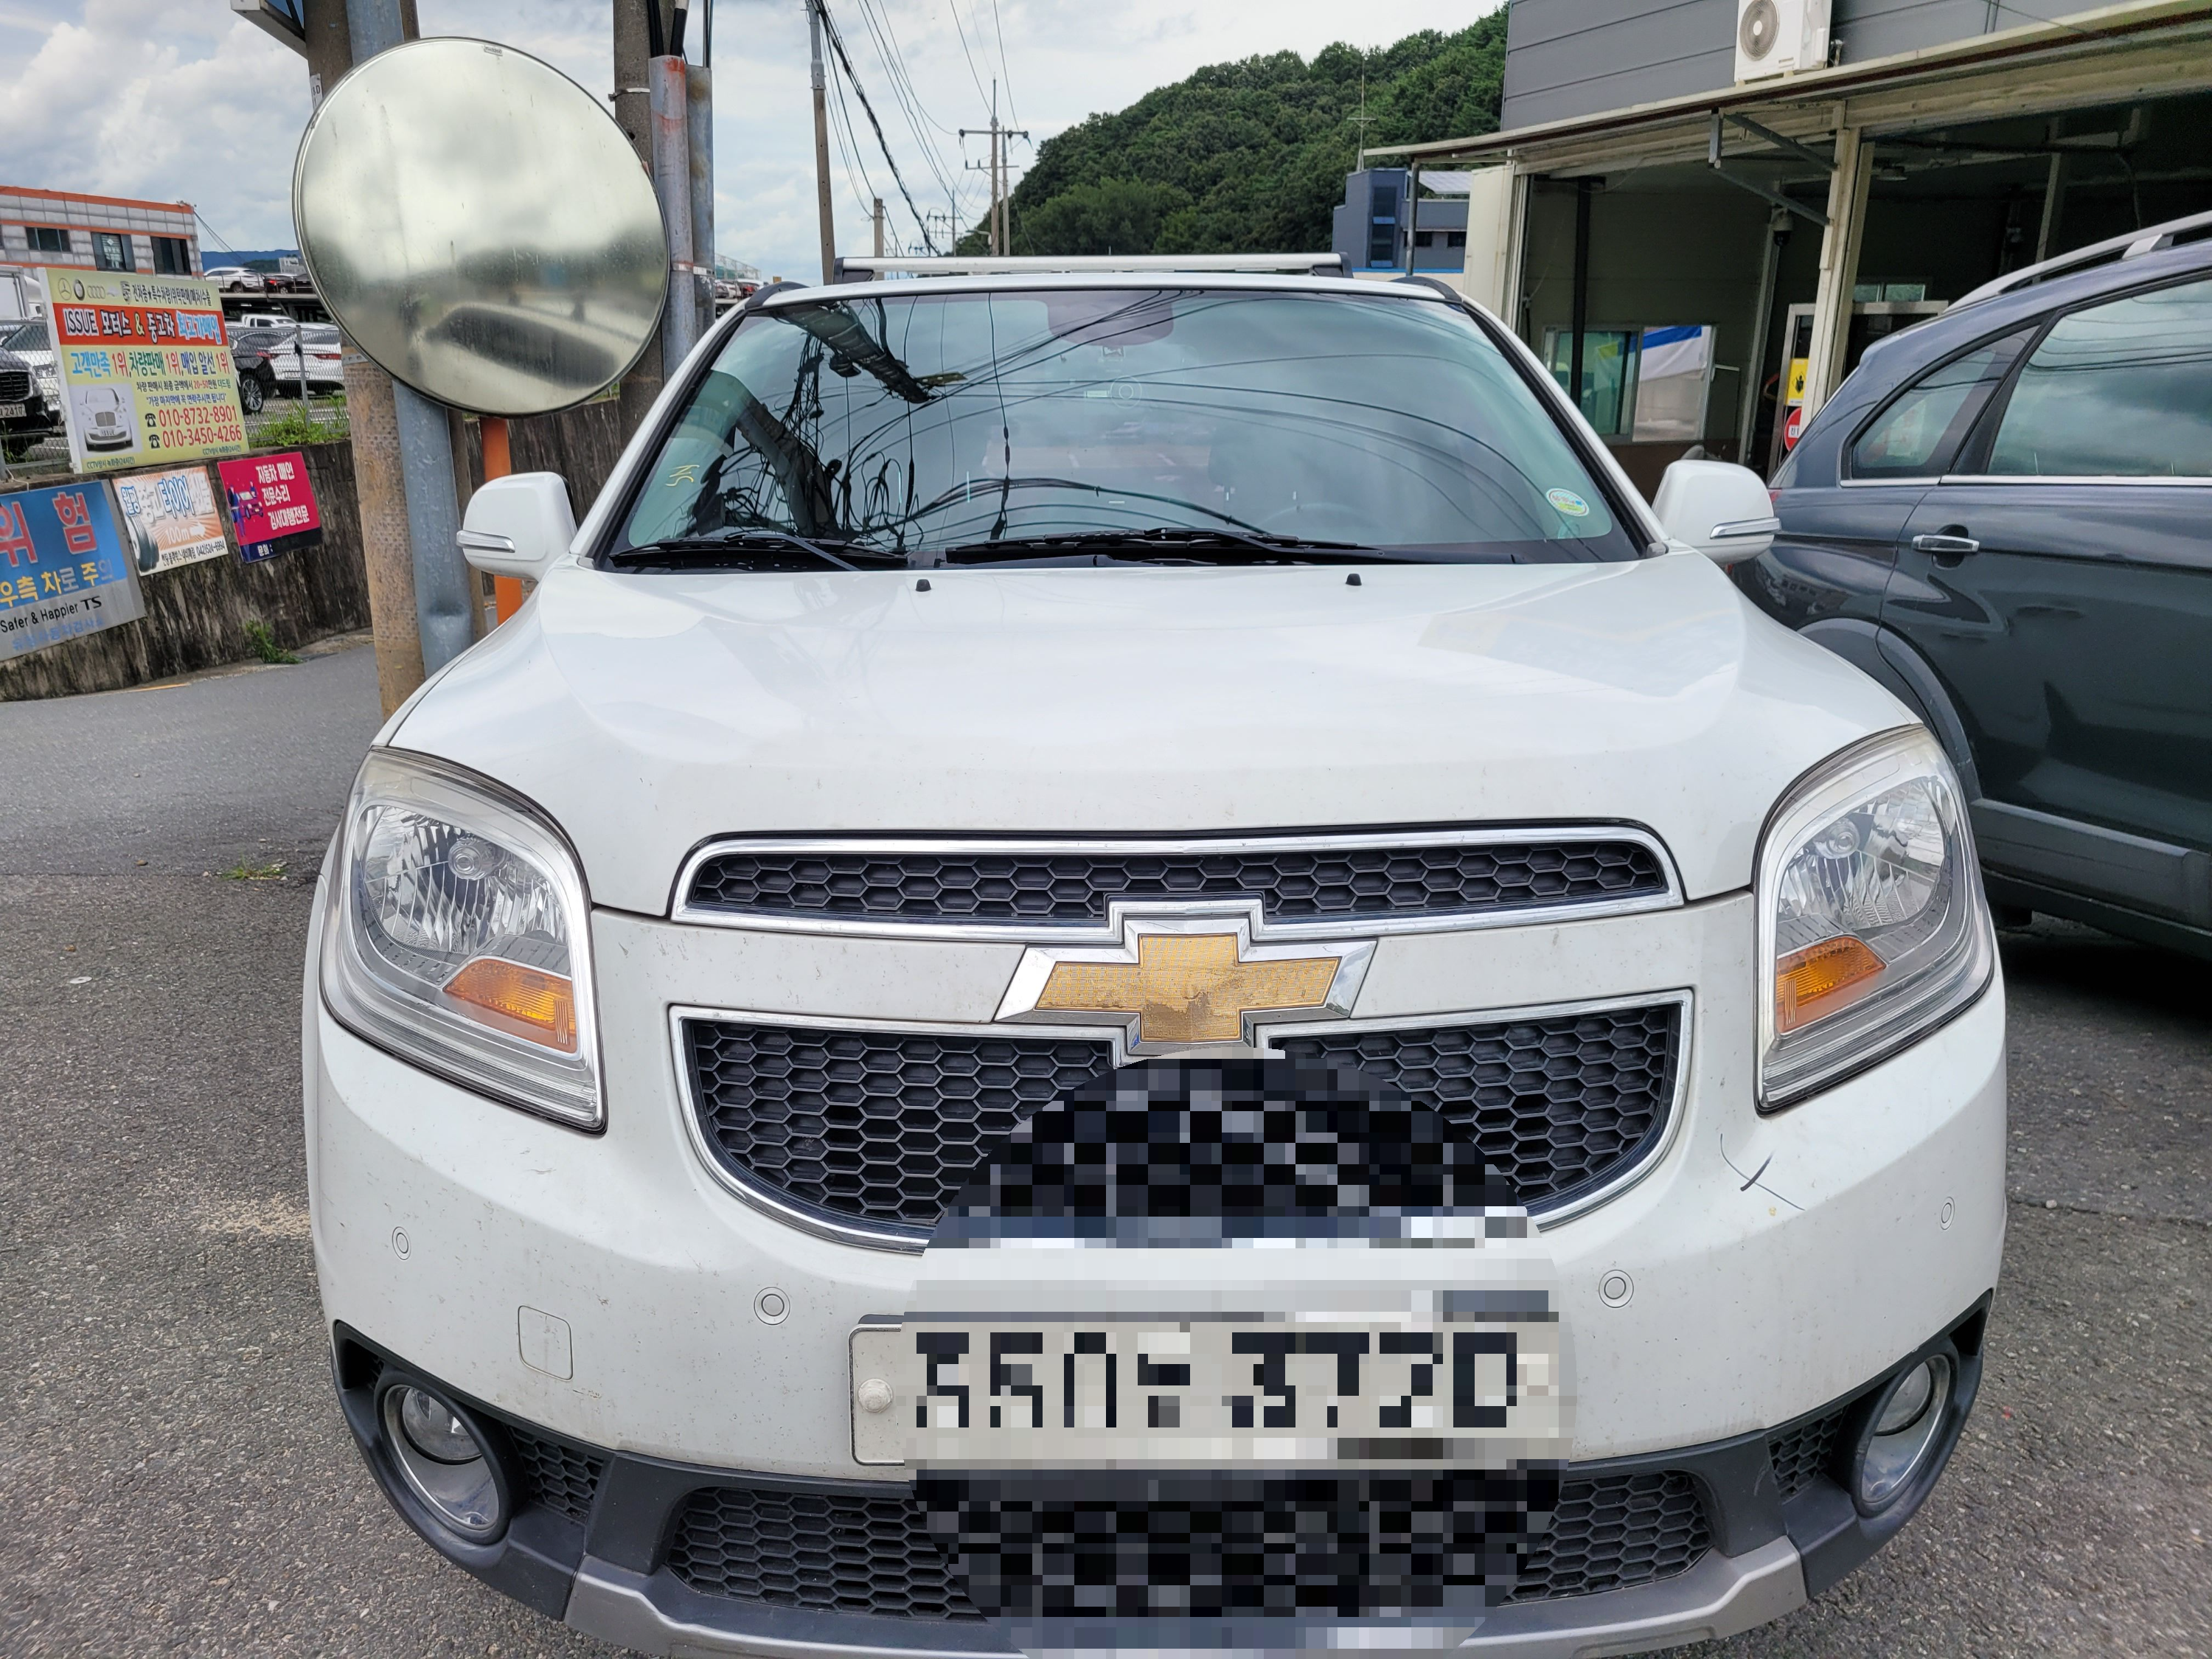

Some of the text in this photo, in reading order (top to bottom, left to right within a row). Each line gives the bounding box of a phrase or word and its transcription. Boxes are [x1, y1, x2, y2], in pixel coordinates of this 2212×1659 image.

[63, 308, 222, 344] ISSUE 모터스 & 중고차 최고가매입
[71, 351, 111, 378] 고객만족
[199, 352, 217, 375] 알선
[216, 351, 230, 375] 1위
[136, 381, 147, 392] 차량
[147, 380, 163, 392] 판매시
[174, 380, 193, 390] 금액에서
[217, 378, 231, 389] 더드림
[159, 394, 181, 406] 마지막에
[187, 393, 211, 405] 연락주시면
[159, 405, 237, 428] 010-8732-8901
[162, 425, 243, 449] 010-3450-4266
[255, 464, 278, 484] 자동차
[121, 486, 141, 515] 월평
[157, 475, 195, 519] 타이어
[261, 484, 291, 507] 전문수리
[268, 504, 310, 530] 검사대행전문
[165, 526, 190, 545] 100m
[0, 576, 38, 608] 우측
[41, 567, 79, 594] 차로
[0, 596, 102, 633] Safer & Happier TS
